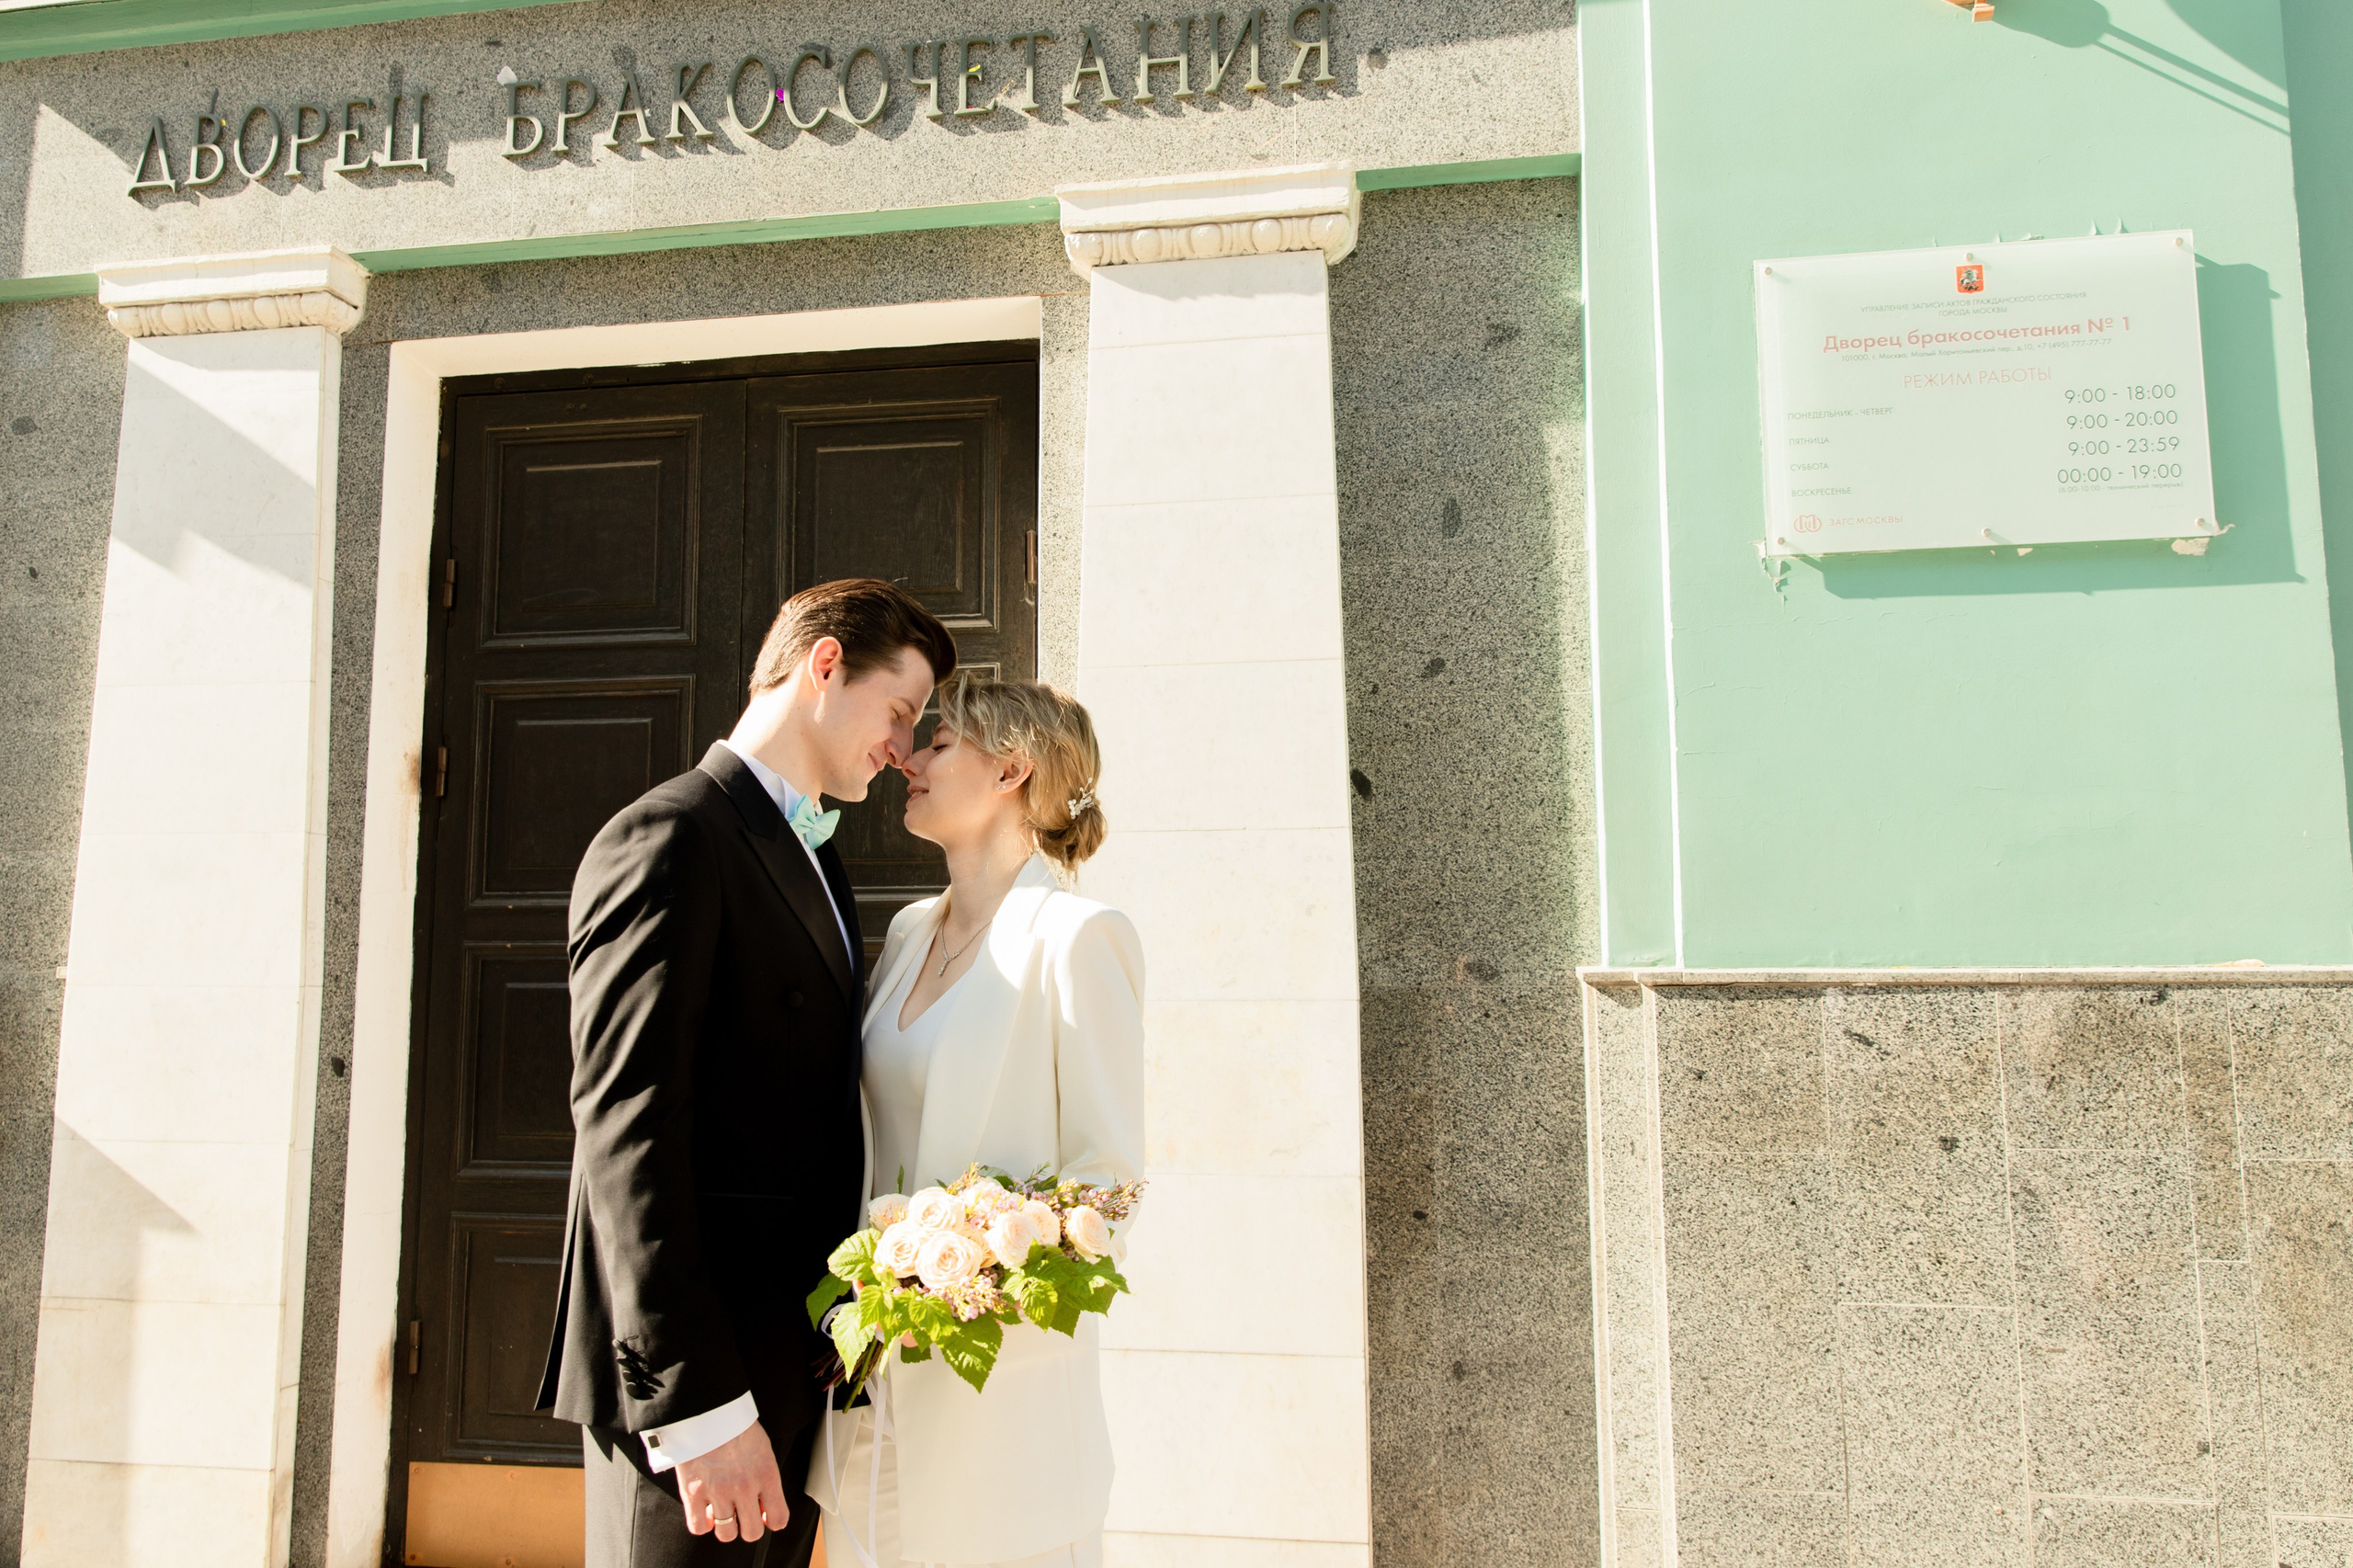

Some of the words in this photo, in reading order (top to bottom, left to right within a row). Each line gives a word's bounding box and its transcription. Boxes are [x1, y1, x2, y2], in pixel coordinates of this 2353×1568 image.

[127, 92, 428, 197] ДВОРЕЦ
[501, 2, 1336, 158] БРАКОСОЧЕТАНИЯ
[1859, 303, 1909, 313] УПРАВЛЕНИЕ
[1911, 301, 1944, 310] ЗАПИСИ
[1946, 299, 1971, 308] АКТОВ
[1972, 295, 2035, 306] ГРАЖДАНСКОГО
[2037, 291, 2087, 302] СОСТОЯНИЯ
[1938, 308, 1970, 318] ГОРОДА
[1972, 306, 2007, 315] МОСКВЫ
[1823, 335, 1902, 354] Дворец
[1906, 323, 2081, 349] бракосочетания
[2121, 315, 2131, 332] 1
[2048, 341, 2069, 350] (495)
[2070, 337, 2112, 348] 777-77-77
[1903, 371, 1972, 389] РЕЖИМ
[1978, 367, 2051, 384] РАБОТЫ
[2064, 388, 2106, 403] 9:00
[2126, 383, 2177, 401] 18:00
[1788, 409, 1853, 420] ПОНЕДЕЛЬНИК
[1860, 406, 1893, 416] ЧЕТВЕРГ
[2066, 414, 2108, 429] 9:00
[2124, 410, 2177, 426] 20:00
[1789, 437, 1830, 446] ПЯТНИЦА
[2067, 440, 2109, 456] 9:00
[2126, 437, 2179, 453] 23:59
[1790, 462, 1829, 472] СУББОТА
[2057, 467, 2111, 483] 00:00
[2131, 463, 2182, 479] 19:00
[1791, 486, 1852, 497] ВОСКРЕСЕНЬЕ
[1828, 517, 1855, 527] ЗАГС
[1856, 515, 1904, 525] МОСКВЫ
